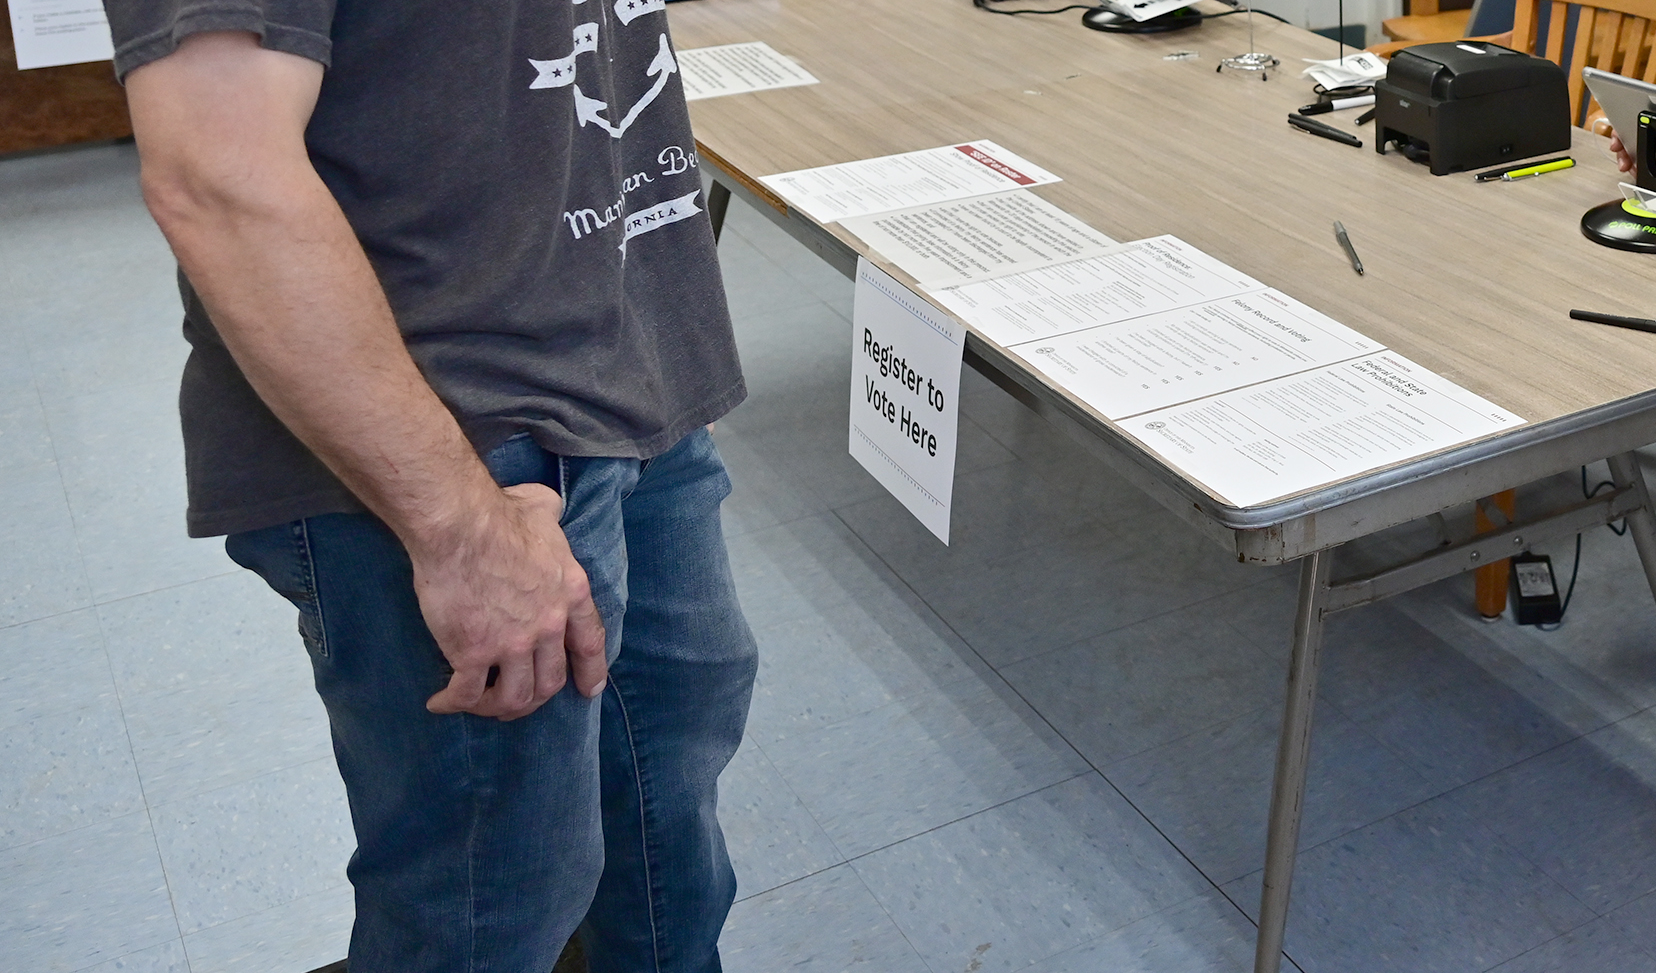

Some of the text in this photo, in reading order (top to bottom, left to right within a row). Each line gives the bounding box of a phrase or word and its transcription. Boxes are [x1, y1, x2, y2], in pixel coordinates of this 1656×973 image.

[1618, 222, 1641, 231] POLL
[863, 327, 945, 414] Register to
[1349, 363, 1415, 397] Law Prohibitions
[1360, 360, 1430, 395] Federal and State
[864, 374, 937, 458] Vote Here
